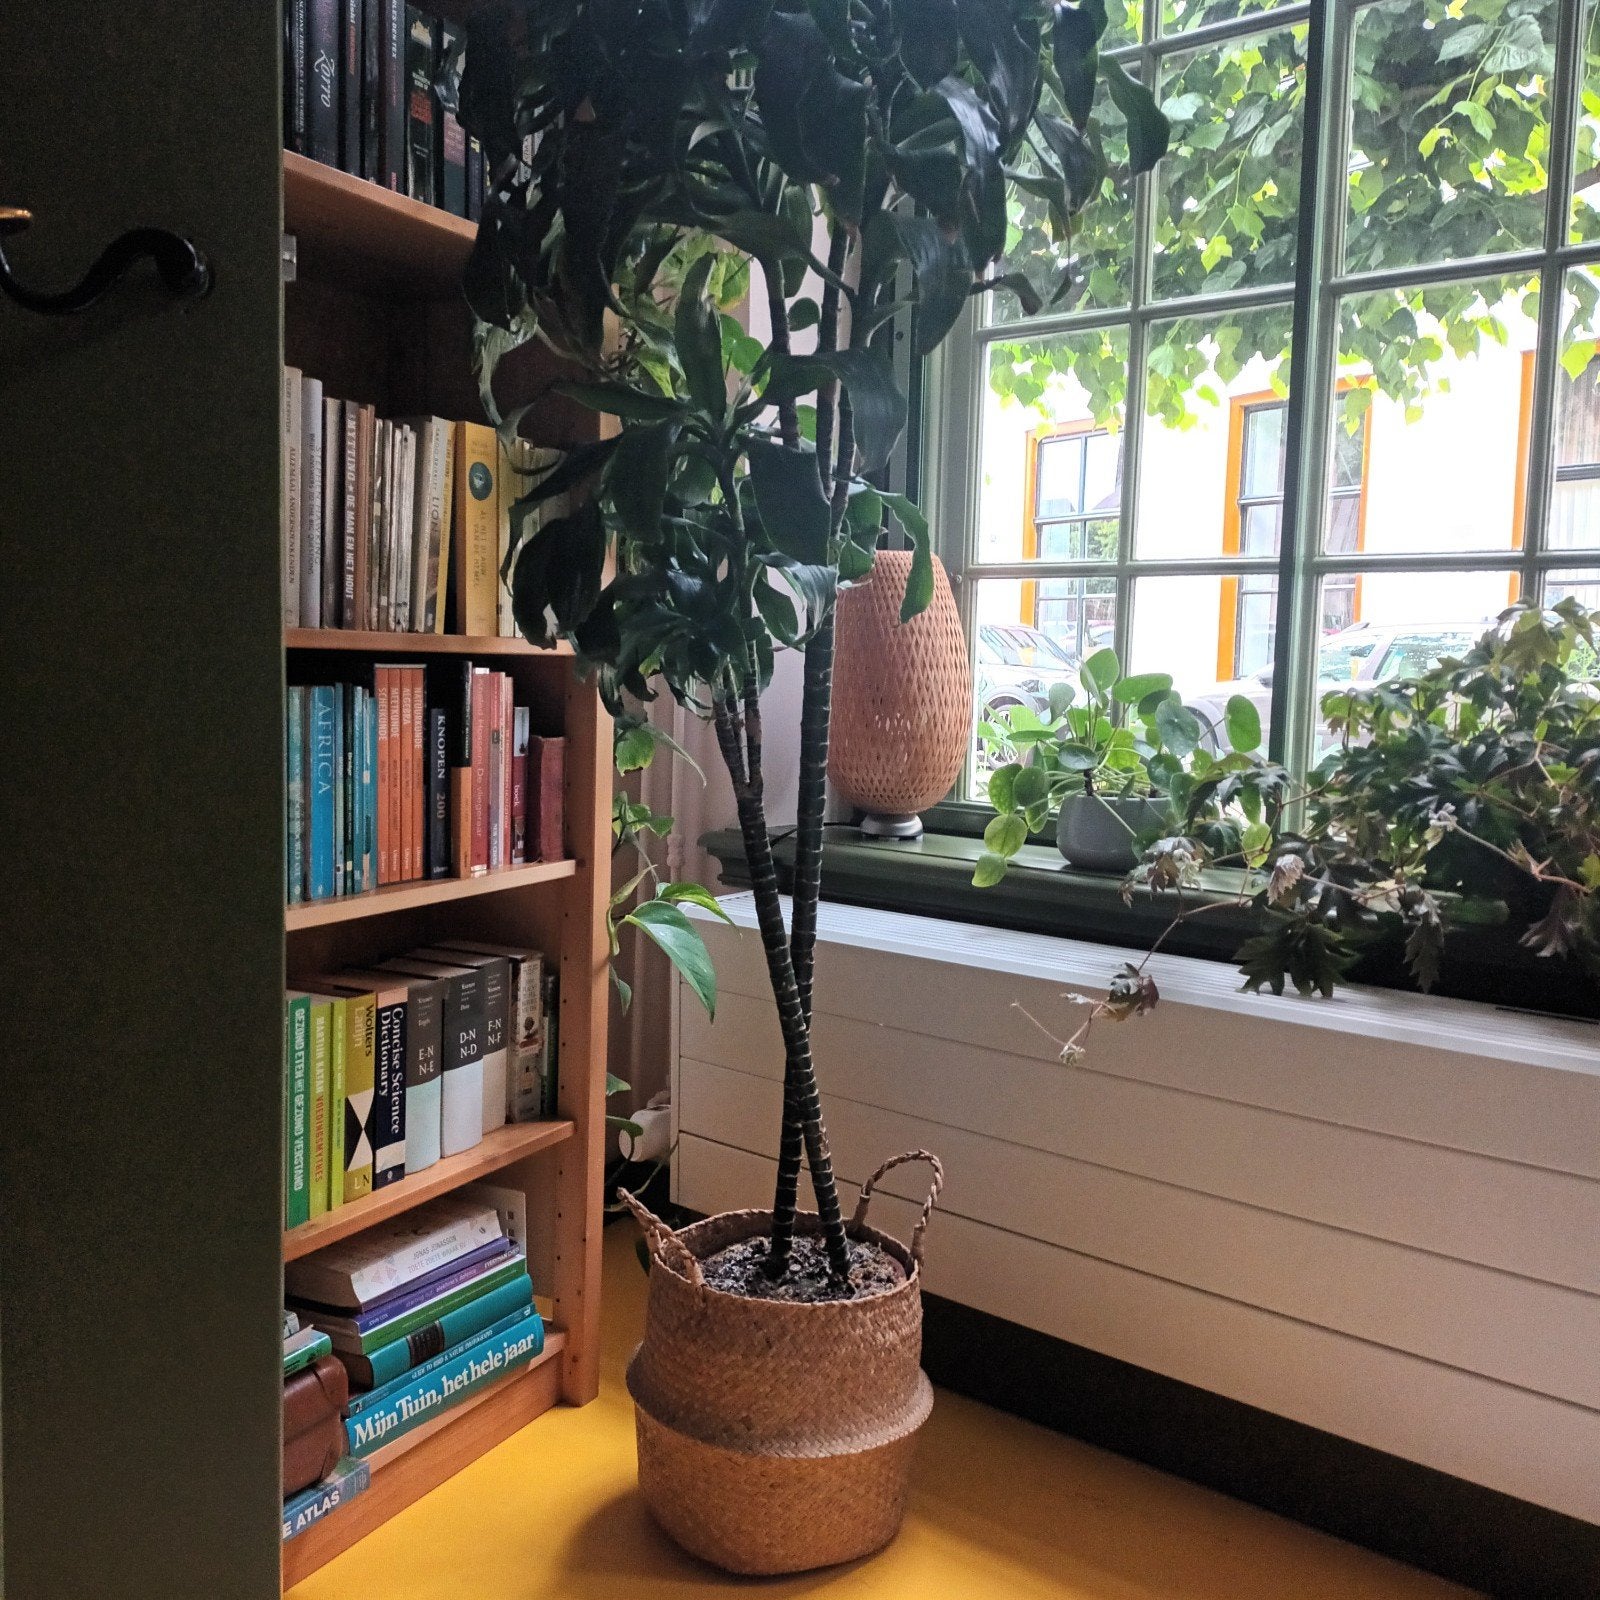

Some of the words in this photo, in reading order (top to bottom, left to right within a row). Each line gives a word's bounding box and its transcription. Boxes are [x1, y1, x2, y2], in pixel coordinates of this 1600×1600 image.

[314, 50, 335, 108] Zorro
[346, 417, 358, 481] MYTTING
[346, 494, 357, 508] DE
[430, 495, 441, 533] LION
[346, 510, 356, 533] MAN
[345, 536, 355, 550] EN
[345, 552, 355, 571] HET
[345, 573, 355, 600] HOUT
[377, 686, 388, 742] SCHEIKUNDE
[390, 686, 400, 738] MEETKUNDE
[402, 686, 411, 726] ALGEBRA
[413, 686, 423, 750] NATUURKUNDE
[317, 704, 331, 795] AFRICA
[437, 715, 446, 780] KNOPEN
[476, 718, 485, 765] Hosseini
[476, 767, 484, 784] De
[436, 792, 446, 820] 200
[475, 786, 484, 838] vliegeraar
[294, 1008, 305, 1050] GEZOND
[316, 1015, 325, 1060] MARTIJN
[353, 1006, 365, 1048] Latijn
[364, 1004, 374, 1057] Wolters
[391, 1007, 404, 1069] Concise
[459, 1028, 477, 1044] D-N
[487, 1018, 502, 1032] F-N
[487, 1032, 502, 1046] N-F
[294, 1051, 304, 1079] ETEN
[379, 1011, 391, 1097] Dictionary
[418, 1045, 434, 1061] E-N
[418, 1060, 435, 1076] N-E
[460, 1043, 477, 1059] N-D
[316, 1061, 325, 1093] KATAN
[294, 1094, 305, 1136] GEZOND
[390, 1072, 403, 1134] Science
[293, 1137, 304, 1191] VERSTAND
[413, 1247, 430, 1261] JONAS
[430, 1234, 457, 1255] JONASSON
[407, 1261, 425, 1275] ZOETE
[353, 1411, 399, 1450] Mijn
[395, 1388, 443, 1422] Tuin,
[441, 1367, 470, 1397] het
[468, 1350, 503, 1382] hele
[502, 1332, 535, 1365] jaar
[296, 1490, 340, 1530] ATLAS
